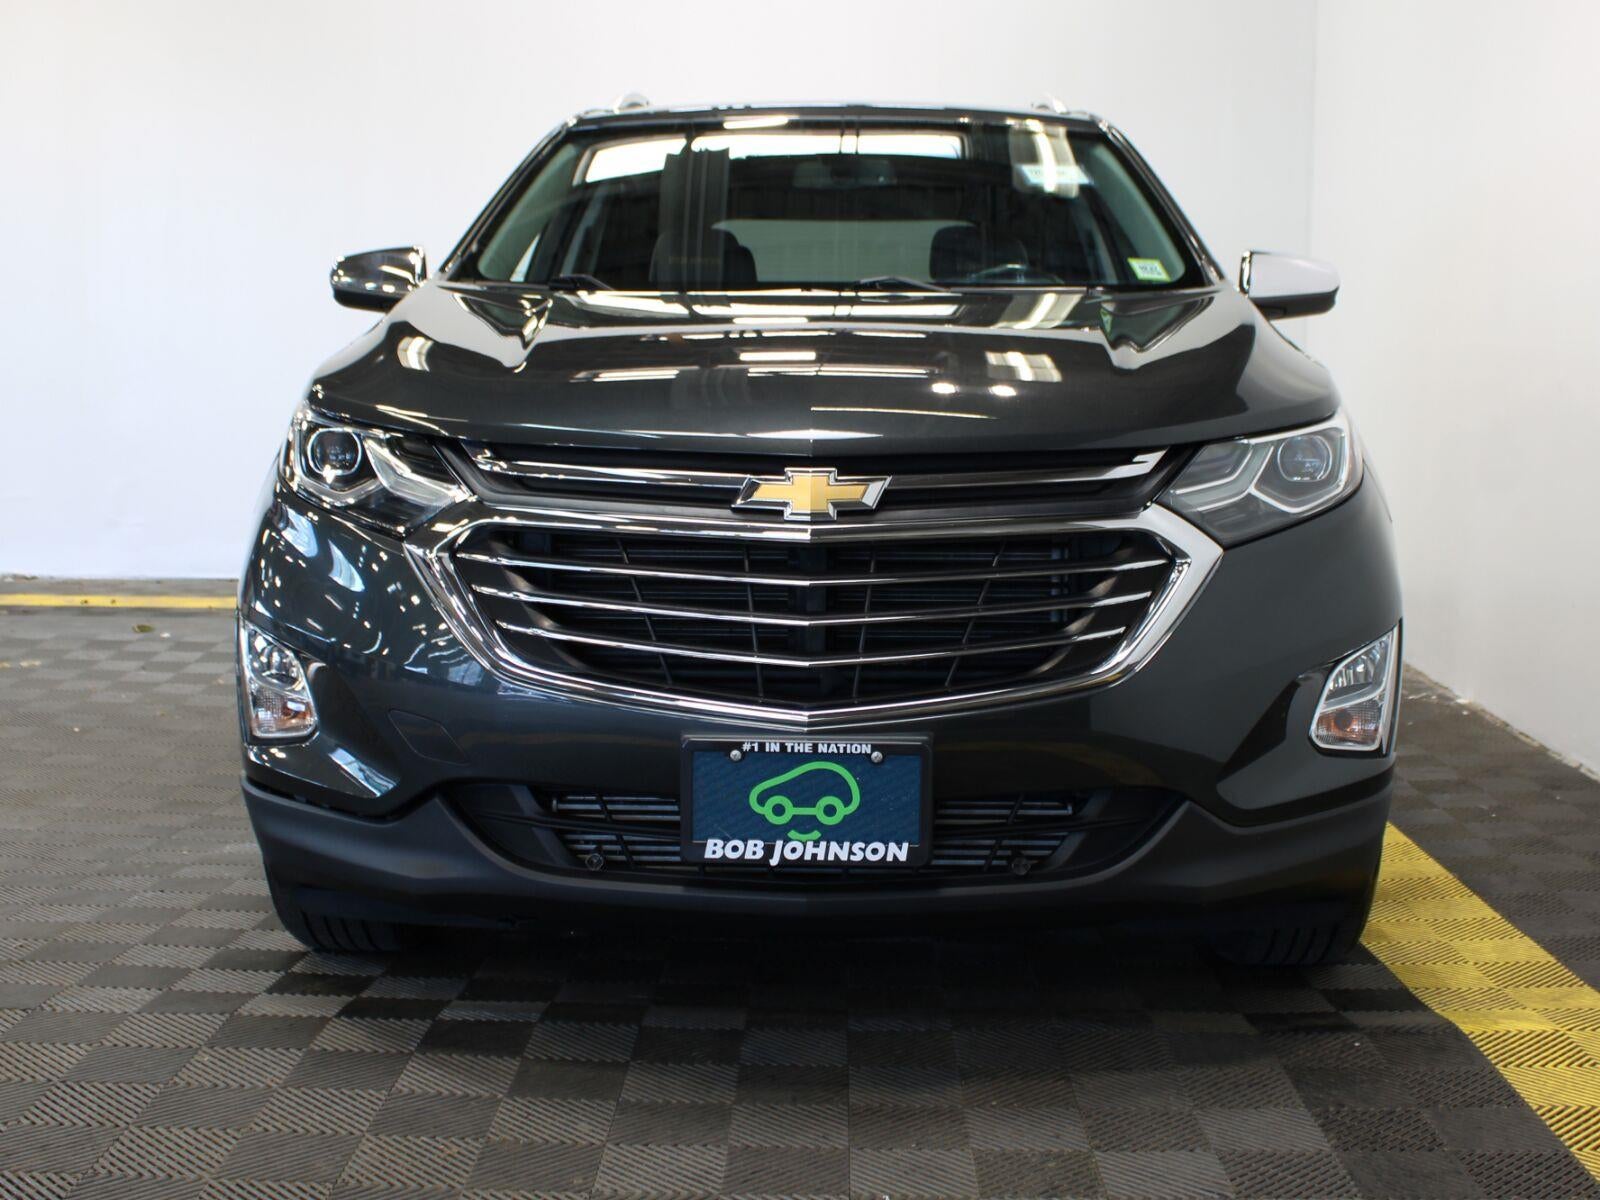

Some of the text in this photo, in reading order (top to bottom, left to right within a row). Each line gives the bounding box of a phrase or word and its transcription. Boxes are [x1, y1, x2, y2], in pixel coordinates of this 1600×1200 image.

[742, 742, 872, 754] #1 IN THE NATION
[704, 839, 909, 866] BOB JOHNSON
